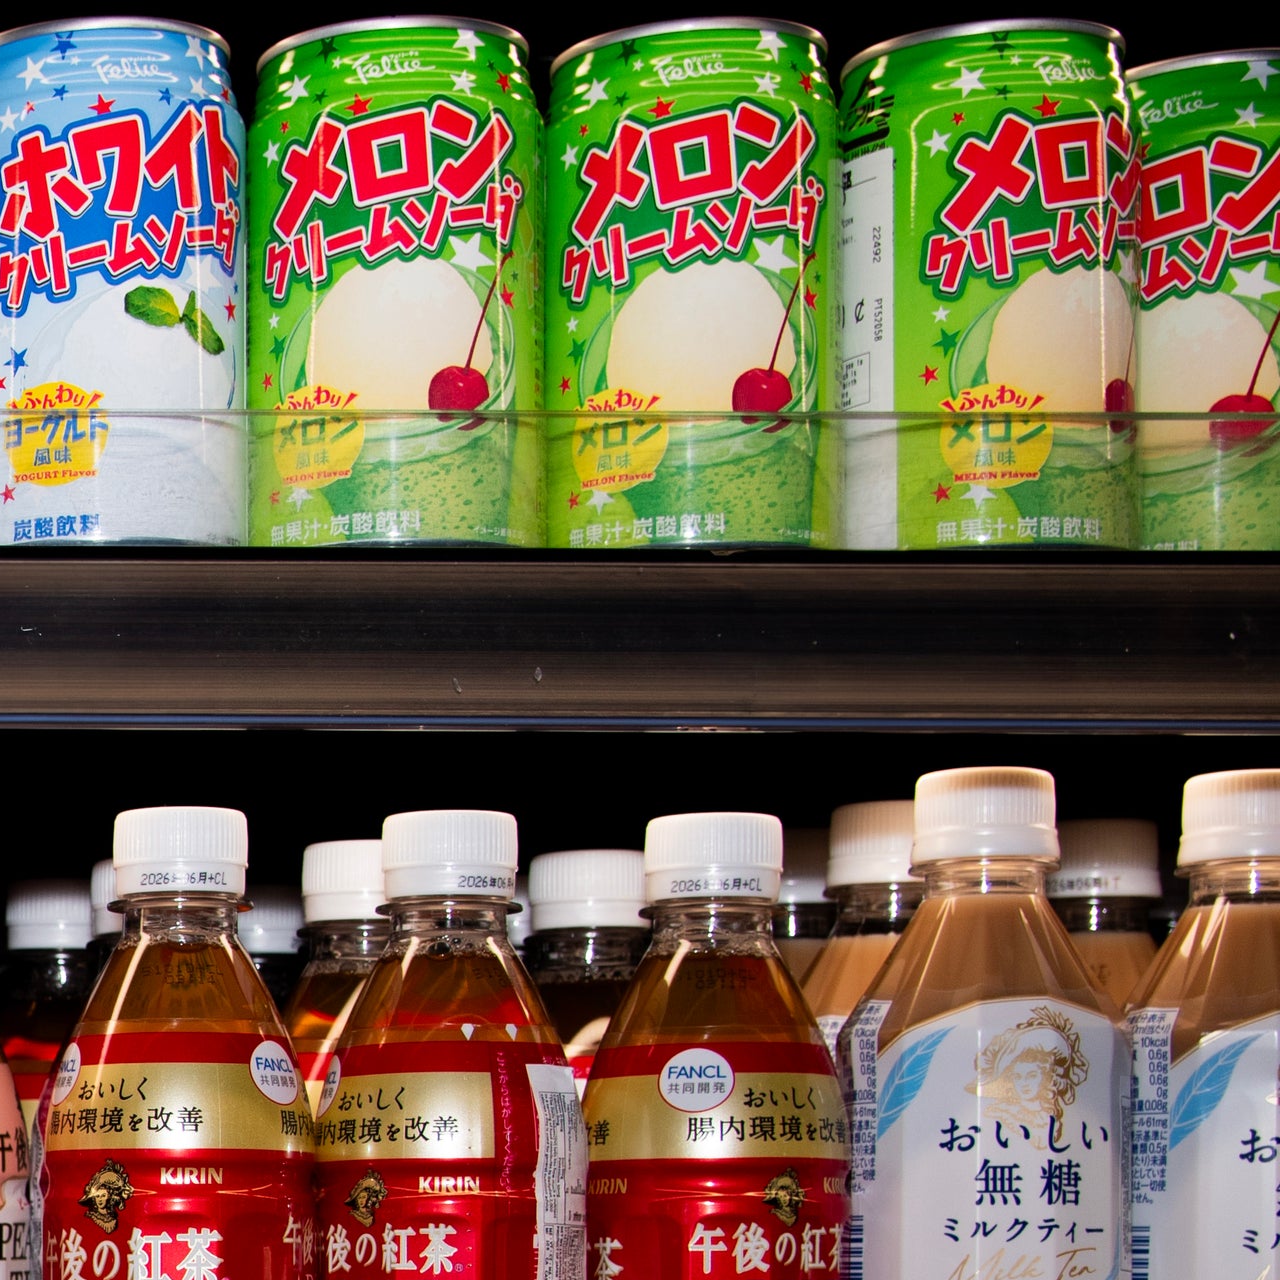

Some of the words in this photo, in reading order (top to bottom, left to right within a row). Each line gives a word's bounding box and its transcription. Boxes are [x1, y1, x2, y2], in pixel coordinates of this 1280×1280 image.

[275, 101, 512, 238] メロン
[573, 102, 815, 243] メロン
[266, 178, 522, 298] クリームソーダ
[563, 179, 825, 302] クリームソーダ
[14, 512, 100, 542] 炭酸飲料
[255, 1057, 293, 1073] FANCL
[668, 1065, 726, 1079] FANCL
[79, 1077, 147, 1101] おいしく
[339, 1086, 406, 1111] おいしく
[668, 1082, 726, 1095] 共同開発
[744, 1087, 816, 1110] おいしく
[49, 1106, 203, 1135] 腸内環境を改善
[687, 1117, 846, 1144] 腸内環境を改善
[939, 1115, 1110, 1153] おいしい
[160, 1167, 223, 1185] KIRIN
[418, 1176, 480, 1193] KIRIN
[975, 1159, 1082, 1207] 無糖
[942, 1217, 1103, 1243] ミルクティー
